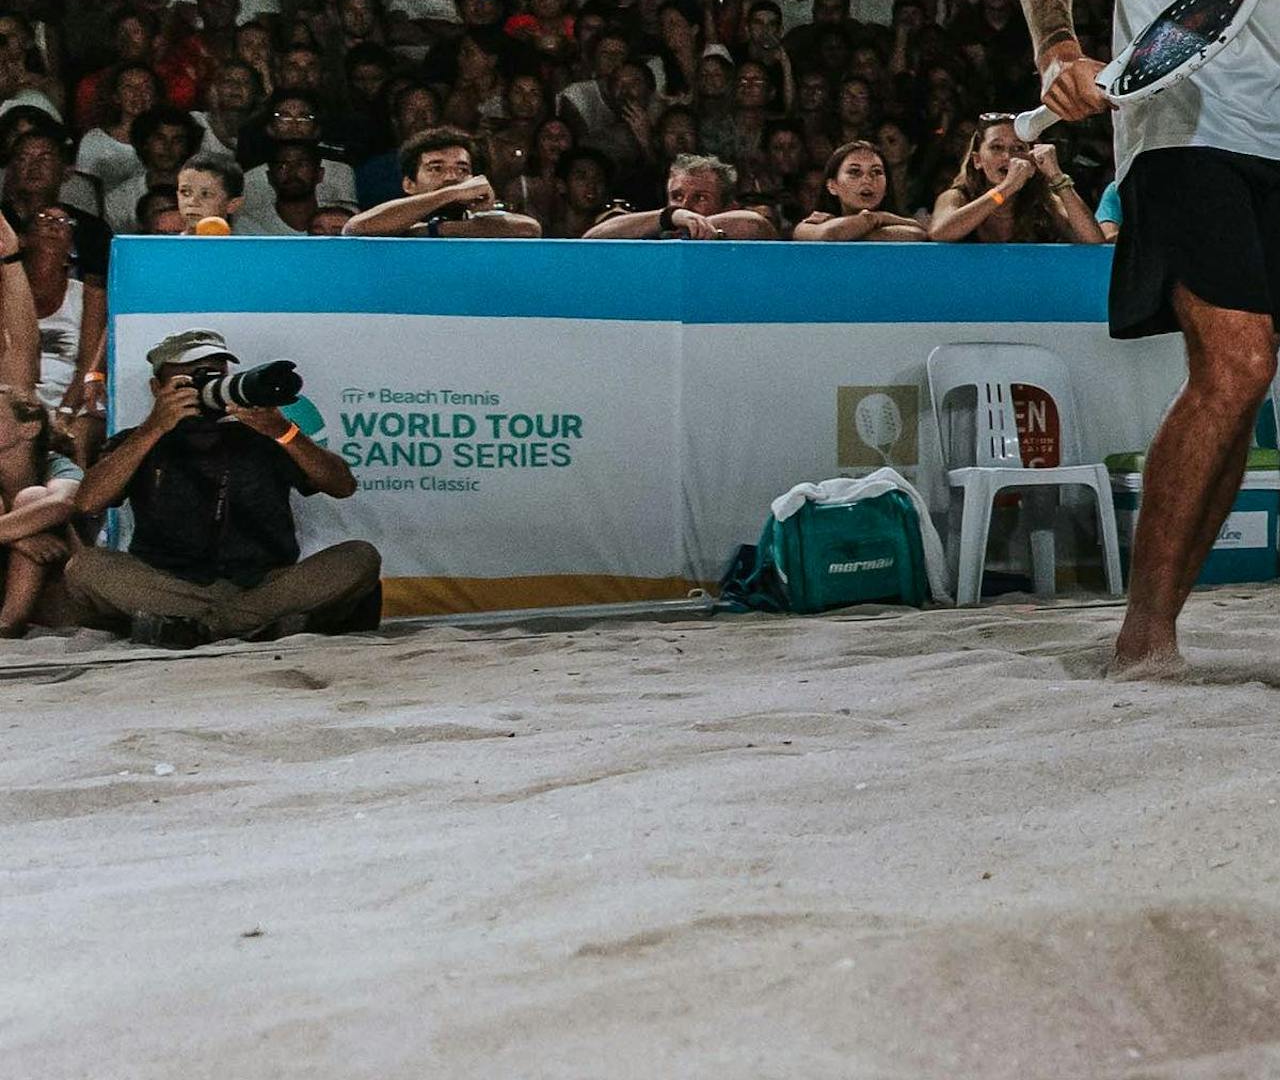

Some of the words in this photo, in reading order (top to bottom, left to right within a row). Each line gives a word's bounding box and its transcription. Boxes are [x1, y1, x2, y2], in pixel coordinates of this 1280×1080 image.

[379, 388, 438, 405] Beach
[439, 389, 501, 406] Tennis
[340, 411, 477, 439] WORLD
[485, 412, 584, 439] TOUR
[341, 441, 442, 468] SAND
[453, 442, 573, 469] SERIES
[357, 474, 415, 492] union
[420, 475, 481, 492] Classic
